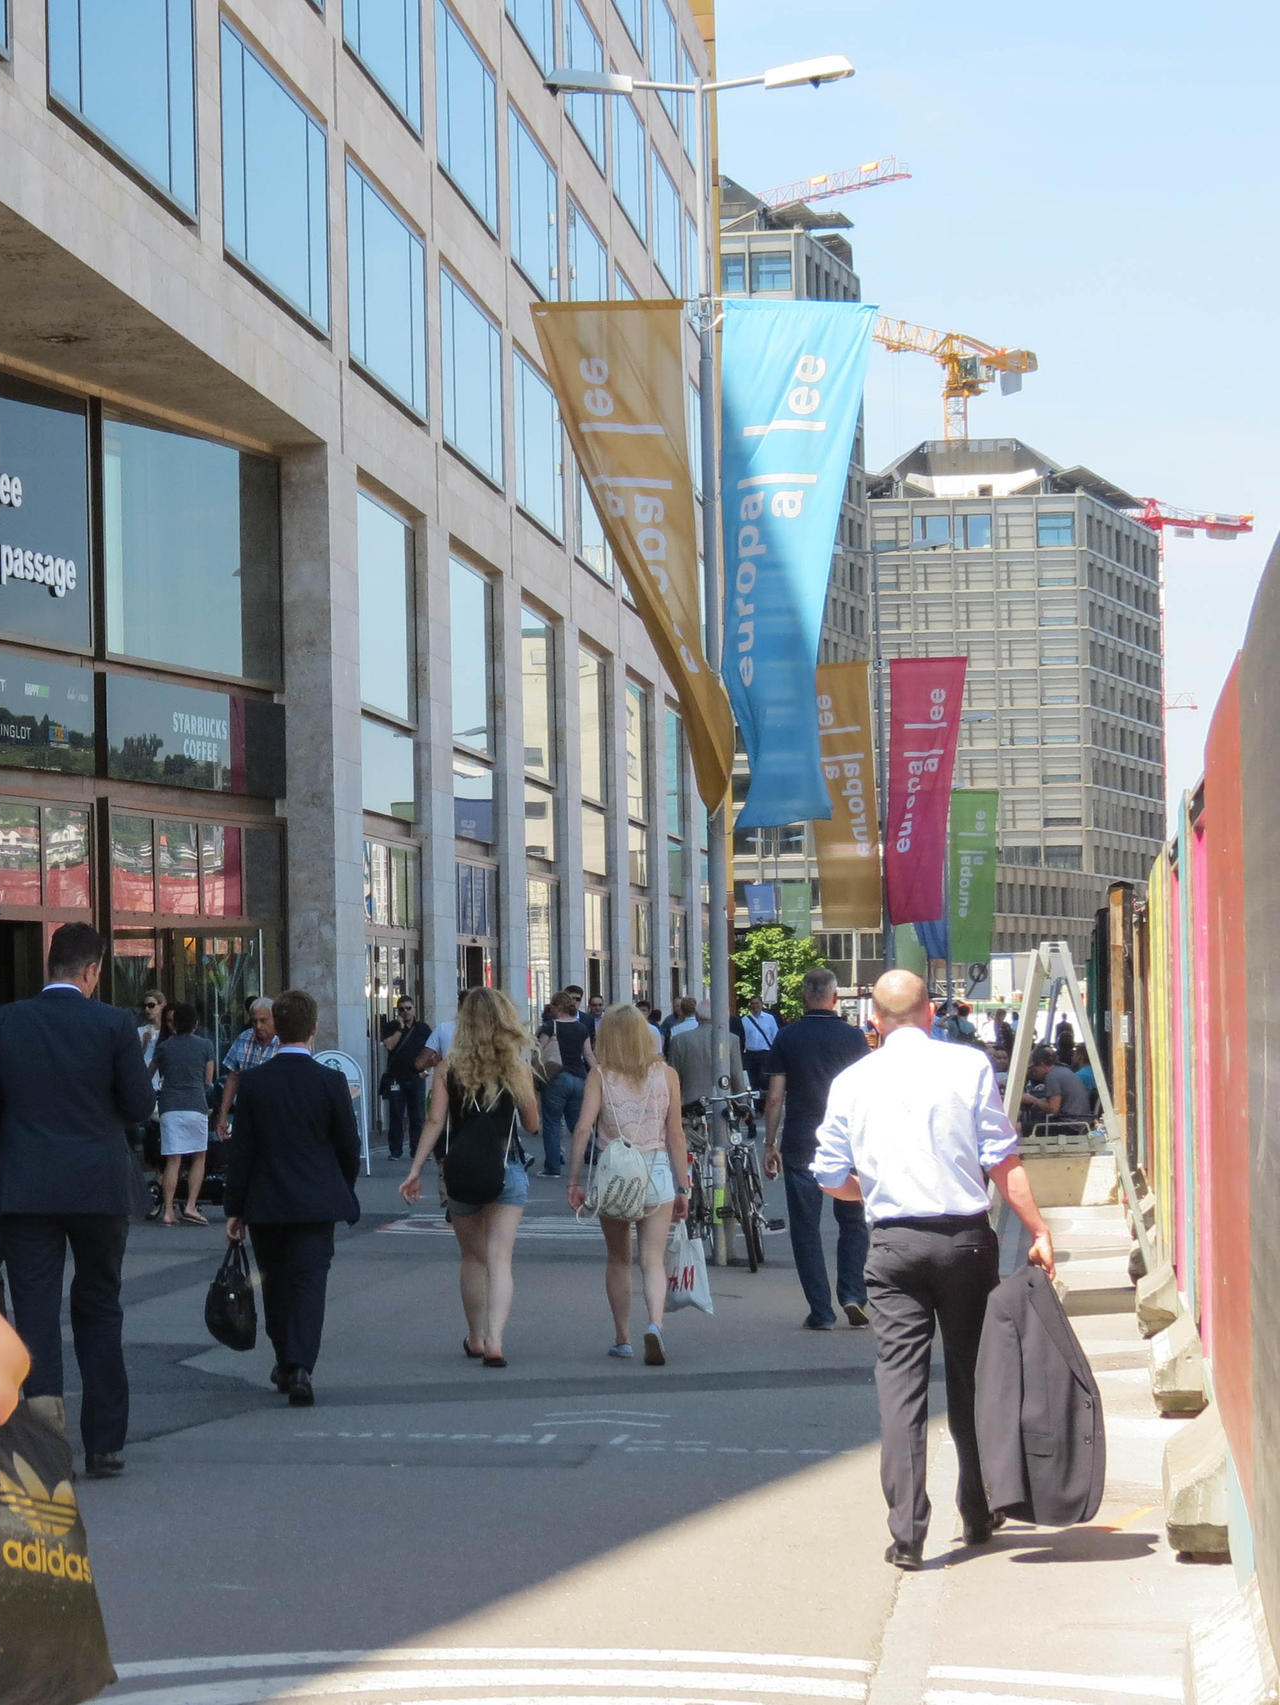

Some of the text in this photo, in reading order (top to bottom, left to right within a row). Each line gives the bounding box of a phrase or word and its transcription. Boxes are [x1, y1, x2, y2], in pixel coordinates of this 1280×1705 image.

[0, 723, 32, 740] INGLOT
[172, 712, 228, 740] STARBUCKS
[183, 738, 218, 762] COFFEE
[2, 1538, 93, 1583] adidas
